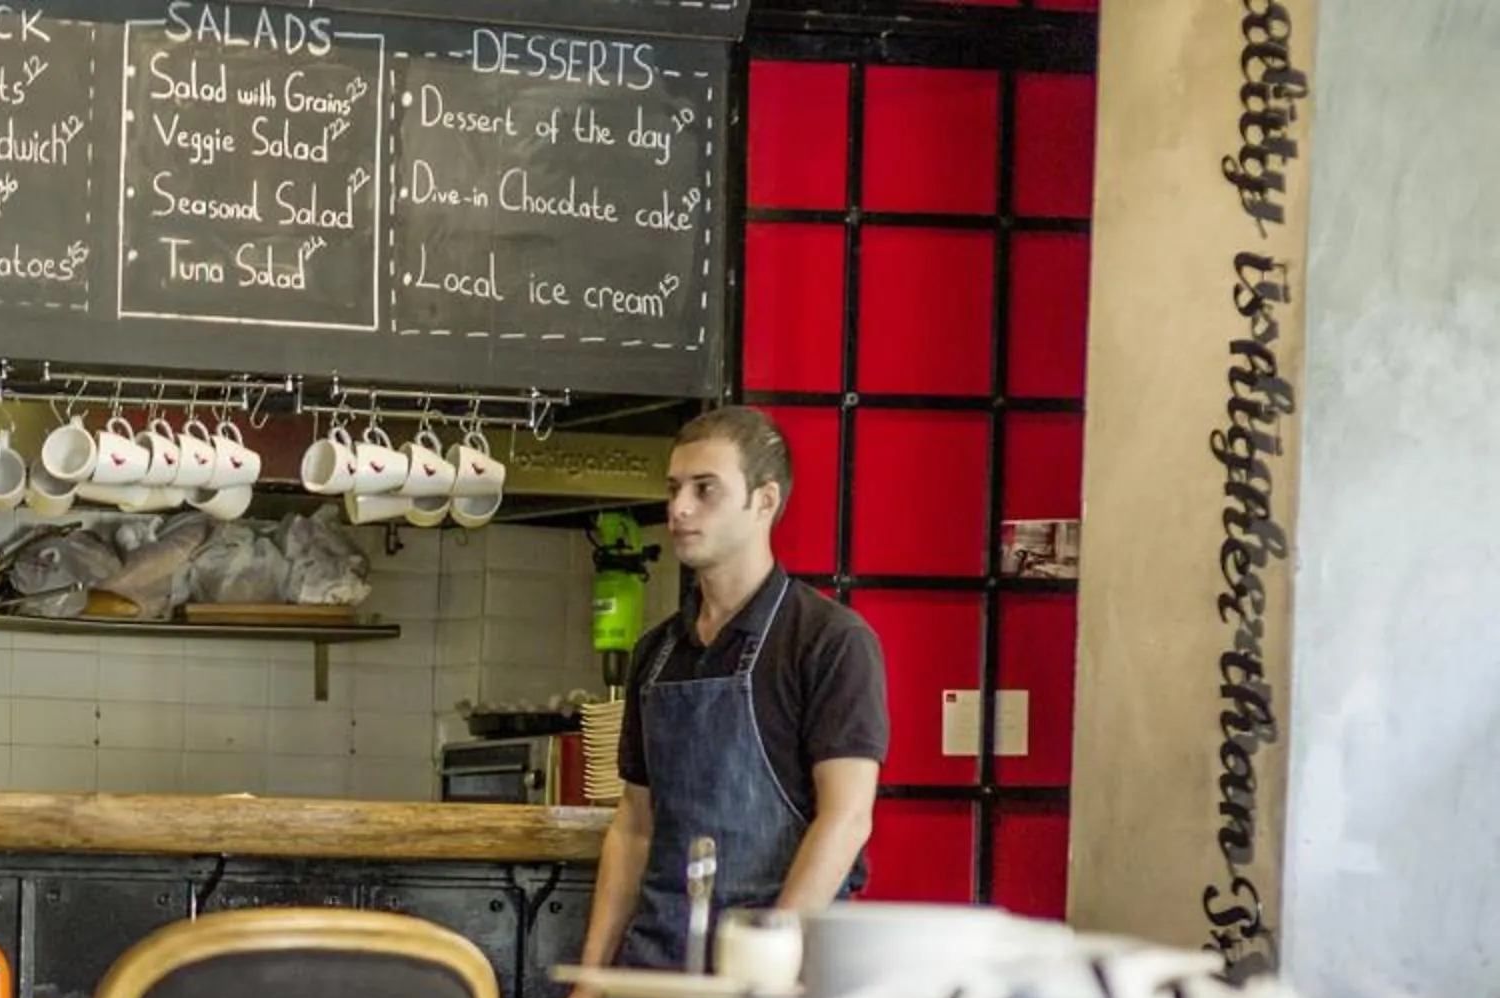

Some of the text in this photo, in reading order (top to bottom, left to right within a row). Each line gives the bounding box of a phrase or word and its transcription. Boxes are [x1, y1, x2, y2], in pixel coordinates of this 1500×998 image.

[165, 2, 332, 55] SALADS
[472, 29, 654, 90] DESSERTS
[150, 52, 228, 103] Salad
[237, 79, 276, 108] with
[284, 71, 351, 115] Grains
[153, 113, 236, 165] Veggie
[251, 116, 328, 162] Salad
[421, 84, 517, 135] Dessert
[536, 107, 561, 144] of
[573, 105, 615, 146] the
[628, 105, 670, 165] day
[152, 171, 263, 221] Seasonal
[276, 181, 354, 228] Salad
[412, 159, 488, 207] Dive-in
[499, 167, 619, 223] Chocolate
[635, 190, 693, 231] cake
[159, 237, 224, 283] Tuna
[236, 243, 305, 289] Salad
[415, 243, 504, 301] Local
[529, 272, 570, 305] ice
[584, 286, 663, 318] cream
[1233, 251, 1278, 317] is
[1209, 339, 1278, 624] higher
[1218, 651, 1274, 876] than
